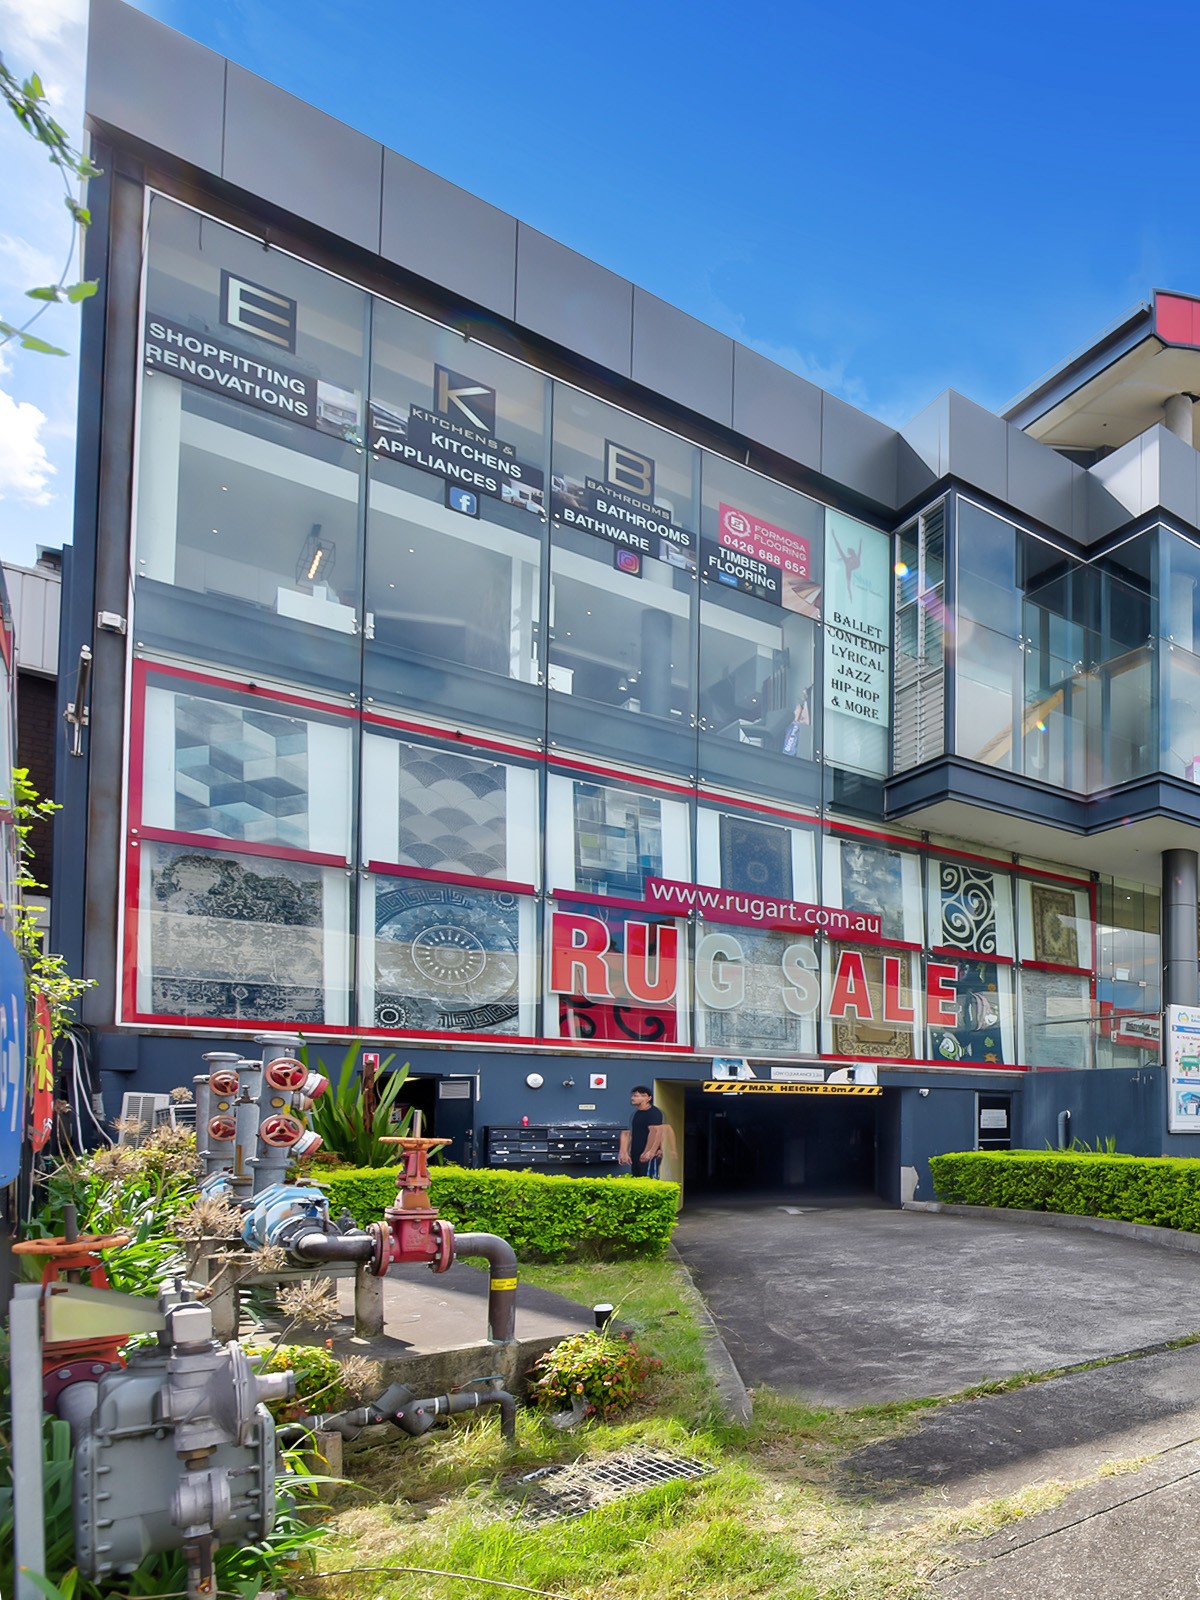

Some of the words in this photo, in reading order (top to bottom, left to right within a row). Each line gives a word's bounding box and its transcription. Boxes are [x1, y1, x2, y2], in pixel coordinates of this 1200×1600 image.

[227, 276, 290, 349] E
[149, 322, 306, 395] SHOPFITTING
[146, 343, 309, 417] RENOVATIONS
[438, 367, 491, 432] K
[412, 408, 498, 449] KITCHENS
[503, 446, 513, 456] &
[376, 436, 497, 491] APPLIANCES
[431, 432, 522, 478] KITCHENS
[608, 444, 651, 496] B
[587, 480, 670, 519] BATHROOMS
[564, 508, 650, 551] BATHWARE
[596, 499, 690, 546] BATHROOMS
[755, 525, 806, 552] FORMOSA
[718, 547, 767, 576] TIMBER
[723, 534, 754, 554] 0426
[759, 549, 780, 565] 688
[785, 560, 806, 576] 652
[754, 534, 807, 562] FLOORING
[709, 556, 776, 591] FLOORING
[828, 626, 885, 655] CONTEMP
[833, 611, 882, 639] BALLET
[832, 644, 884, 673] LYRICAL
[837, 664, 871, 684] JAZZ
[831, 678, 880, 702] HIP-HOP
[831, 696, 841, 707] &
[845, 700, 879, 720] MORE
[651, 882, 880, 933] www.rugart.com.au
[549, 911, 745, 1010] RUG
[782, 943, 959, 1029] SALE
